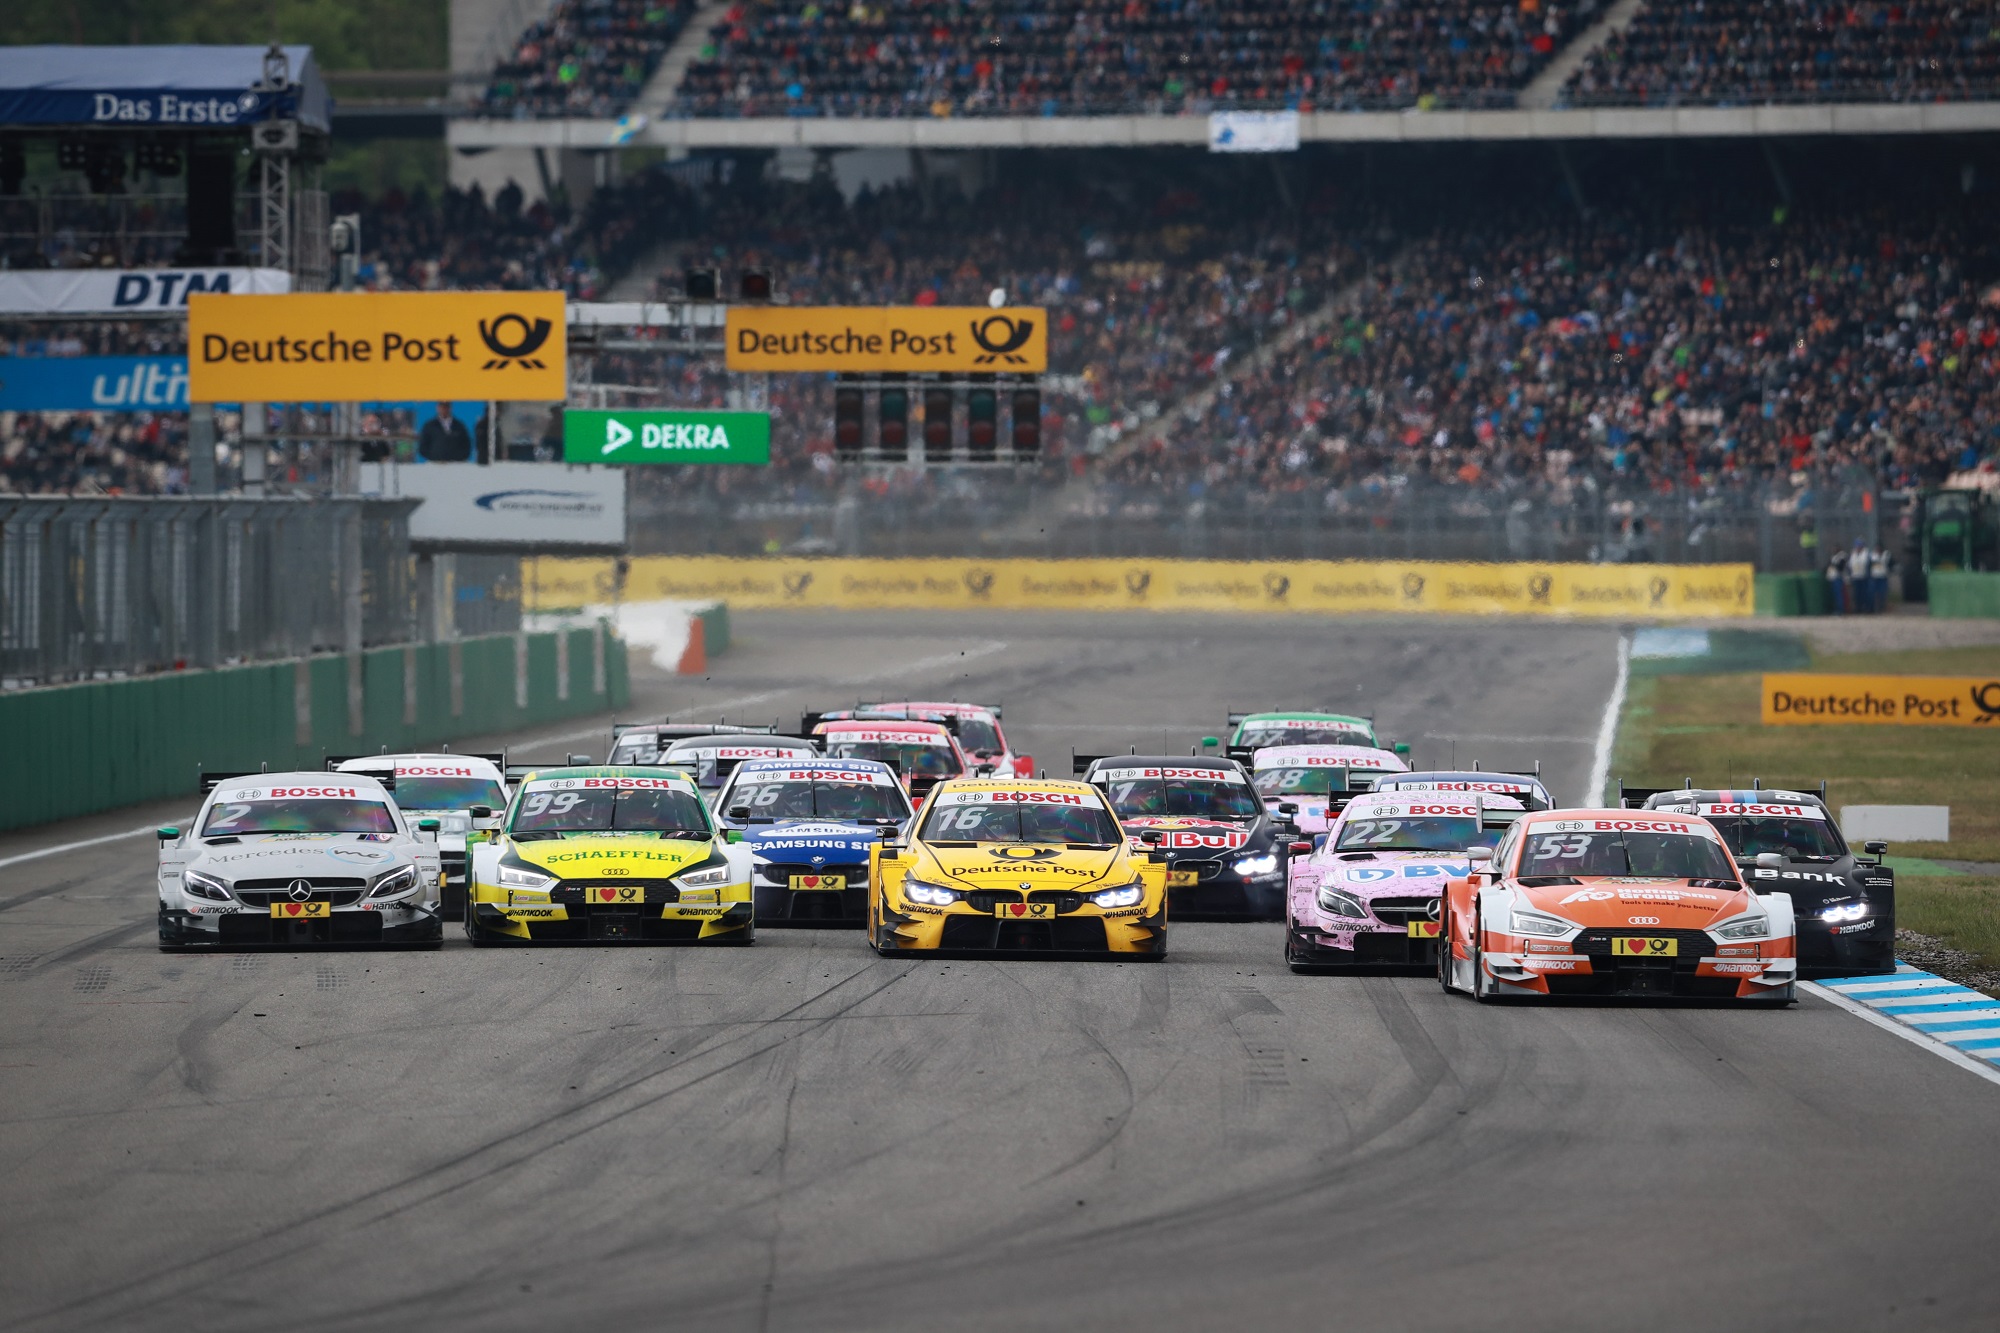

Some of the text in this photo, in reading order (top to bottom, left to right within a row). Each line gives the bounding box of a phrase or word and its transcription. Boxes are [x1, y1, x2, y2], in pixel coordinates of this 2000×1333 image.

[93, 93, 238, 123] Das Erste
[112, 273, 230, 307] DTM
[203, 331, 460, 363] Deutsche Post
[738, 326, 956, 354] Deutsche Post
[91, 363, 190, 405] ulti
[641, 423, 730, 450] DEKRA
[1772, 691, 1960, 718] Deutsche Post
[1287, 720, 1350, 730] BOSCH
[861, 732, 932, 743] BOSCH
[719, 749, 793, 758] BOSCH
[750, 760, 878, 772] SAMSUNG SDI
[1307, 757, 1381, 767] BOSCH
[395, 767, 472, 776] BOSCH
[789, 771, 873, 782] BOSCH
[1143, 769, 1226, 780] BOSCH
[584, 778, 670, 789] BOSCH
[1254, 769, 1305, 789] 48
[271, 787, 356, 798] BOSCH
[1044, 783, 1084, 791] Post
[1437, 782, 1520, 793] BOSCH
[734, 784, 784, 808] 36
[992, 792, 1082, 805] BOSCH
[522, 792, 580, 817] 99
[1710, 804, 1803, 816] BOSCH
[208, 804, 252, 829] 2
[937, 806, 988, 832] 16
[1343, 819, 1402, 846] 22
[1594, 820, 1690, 834] BOSCH
[751, 839, 846, 851] SAMSUNG
[1171, 831, 1249, 849] Bull
[1533, 833, 1593, 861] 53
[208, 848, 325, 865] Mercedes
[333, 848, 382, 859] me
[547, 850, 682, 864] SCHAEFFLER
[952, 865, 1097, 879] Deutsche Post
[1754, 868, 1846, 887] Bank
[1617, 887, 1718, 900] Hoffmann
[1618, 892, 1681, 901] Group
[1692, 903, 1719, 912] better
